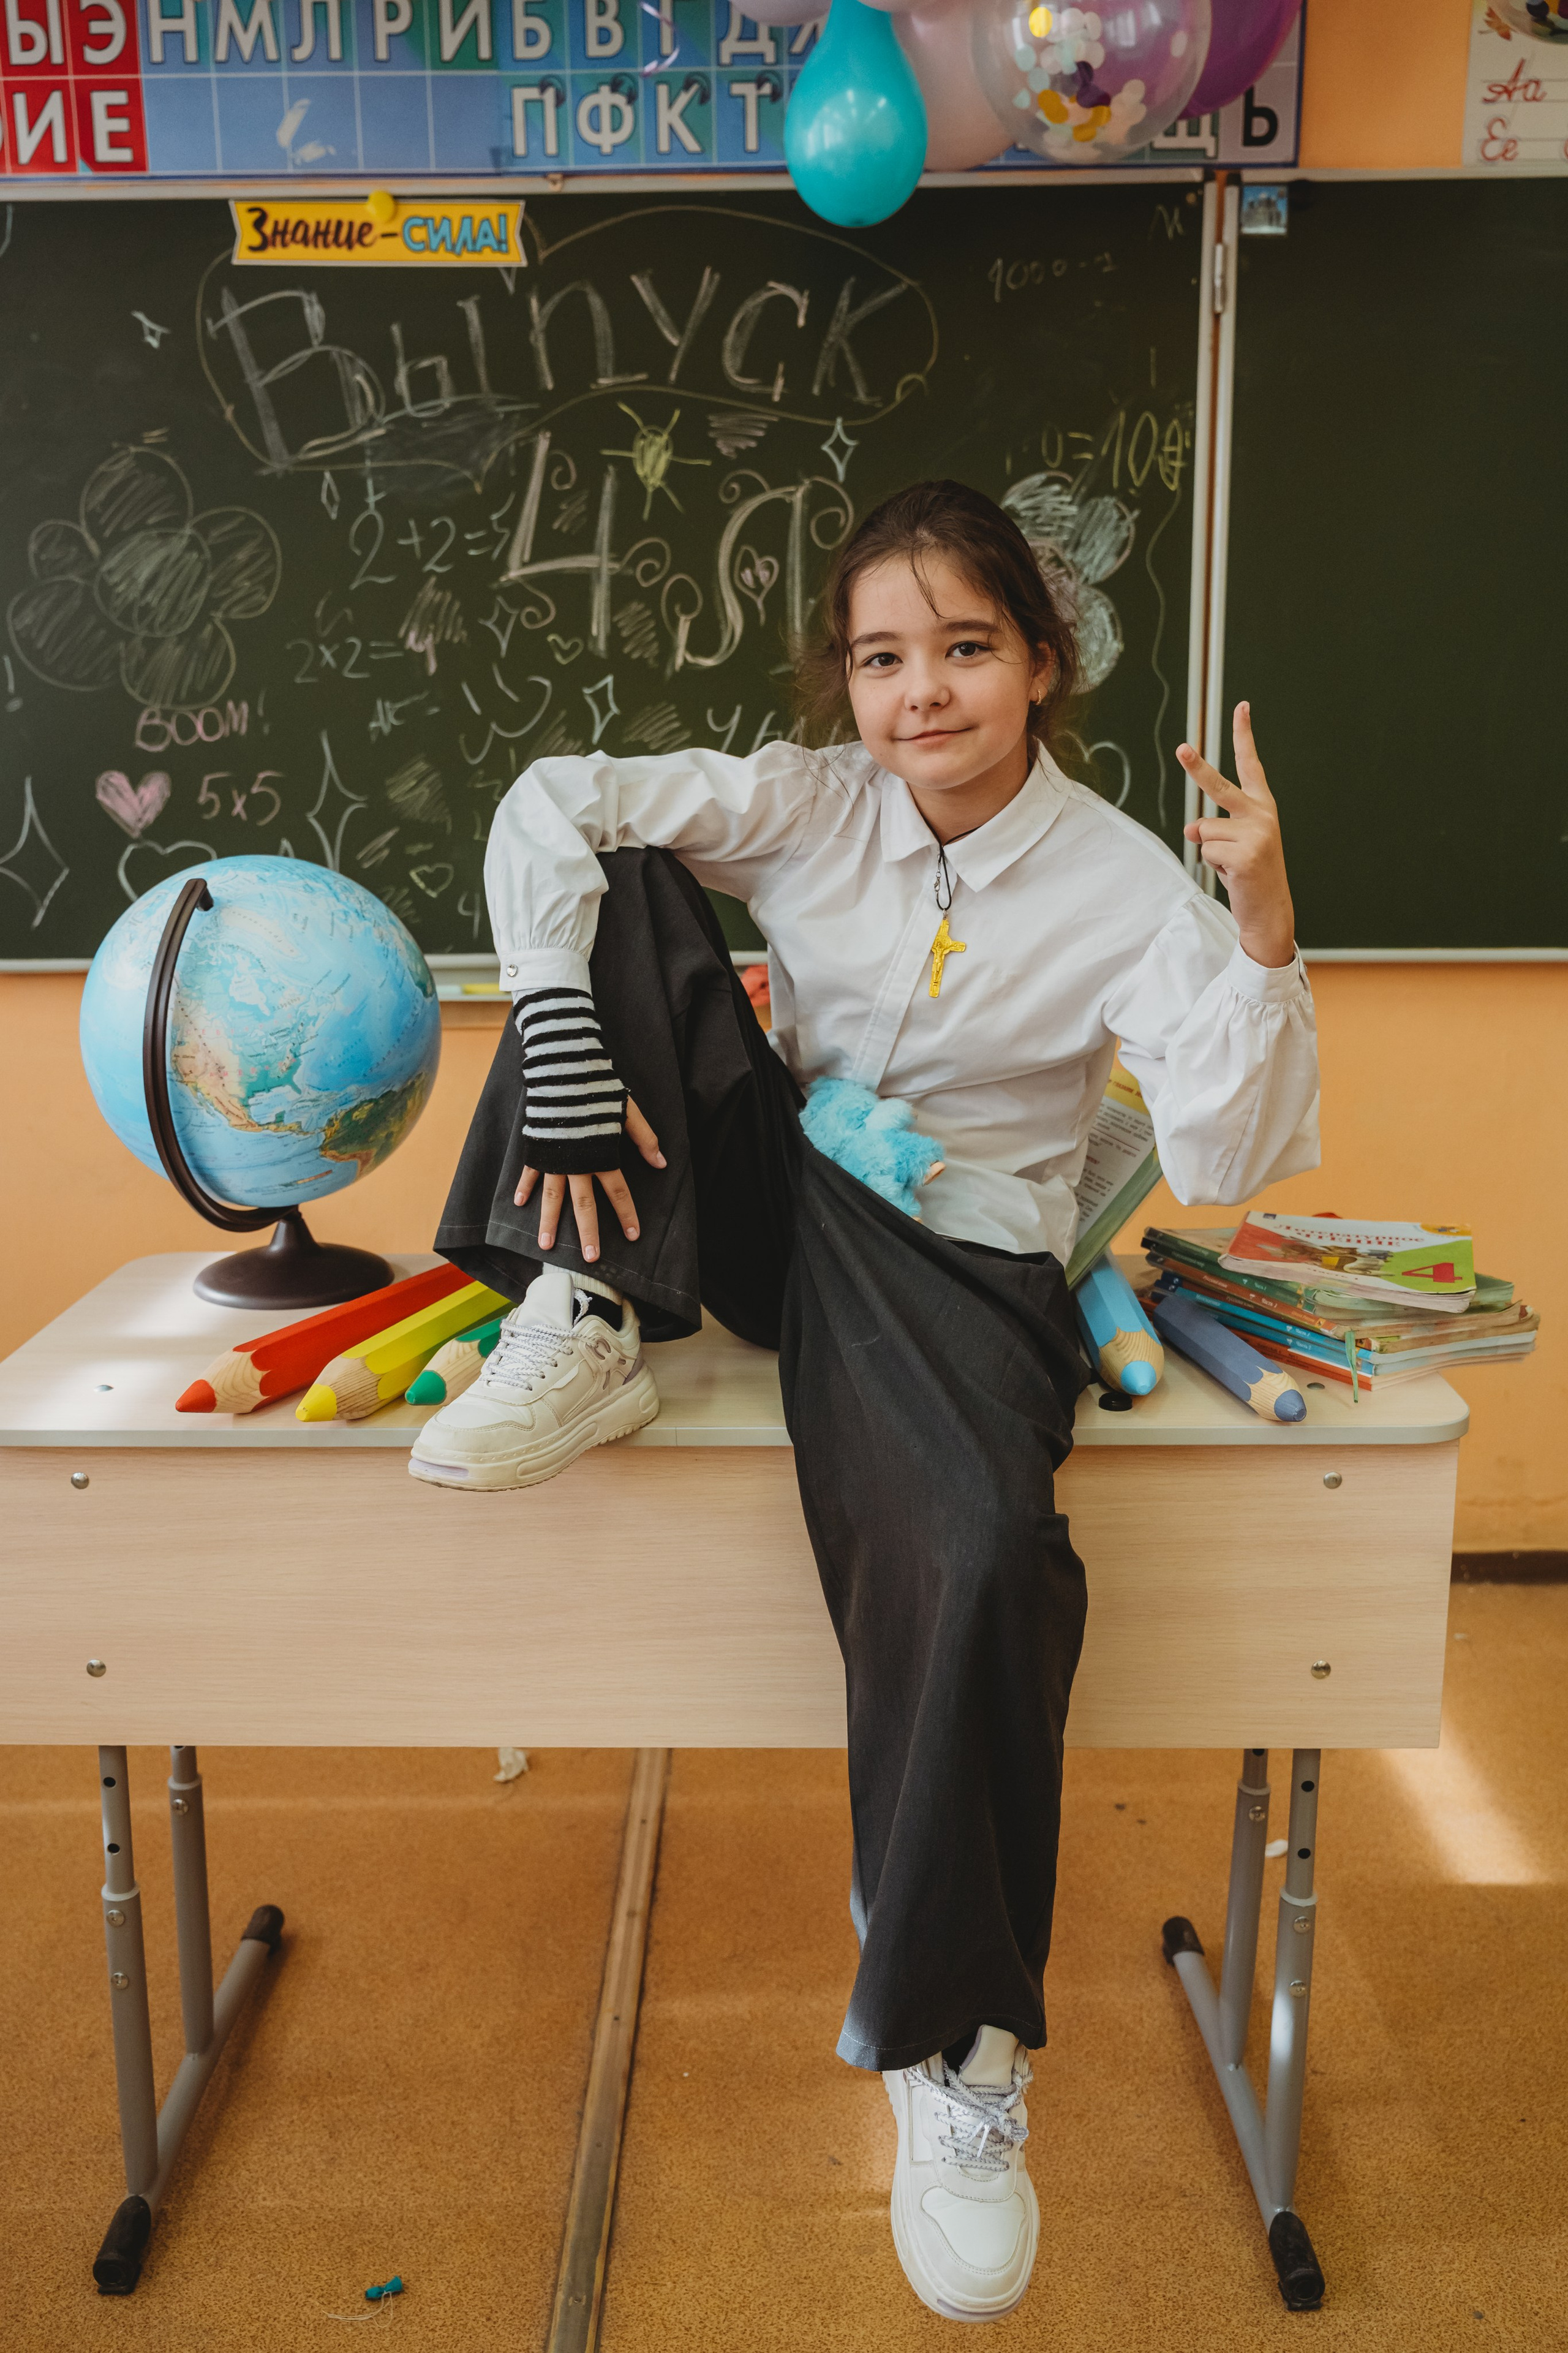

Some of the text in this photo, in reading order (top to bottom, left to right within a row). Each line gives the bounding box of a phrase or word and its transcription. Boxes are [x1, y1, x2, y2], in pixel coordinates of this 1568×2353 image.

[79, 0, 127, 66] Э
[148, 0, 199, 63] Н
[214, 0, 280, 62] М
[291, 0, 344, 61] Л
[374, 0, 413, 61] Р
[512, 0, 552, 60] Б
[584, 0, 625, 58] В
[12, 89, 68, 165] И
[90, 89, 135, 164] Е
[511, 85, 559, 157] П
[578, 85, 635, 155] Ф
[656, 82, 703, 154] К
[729, 81, 772, 153] Т
[1401, 1262, 1463, 1284] 4
